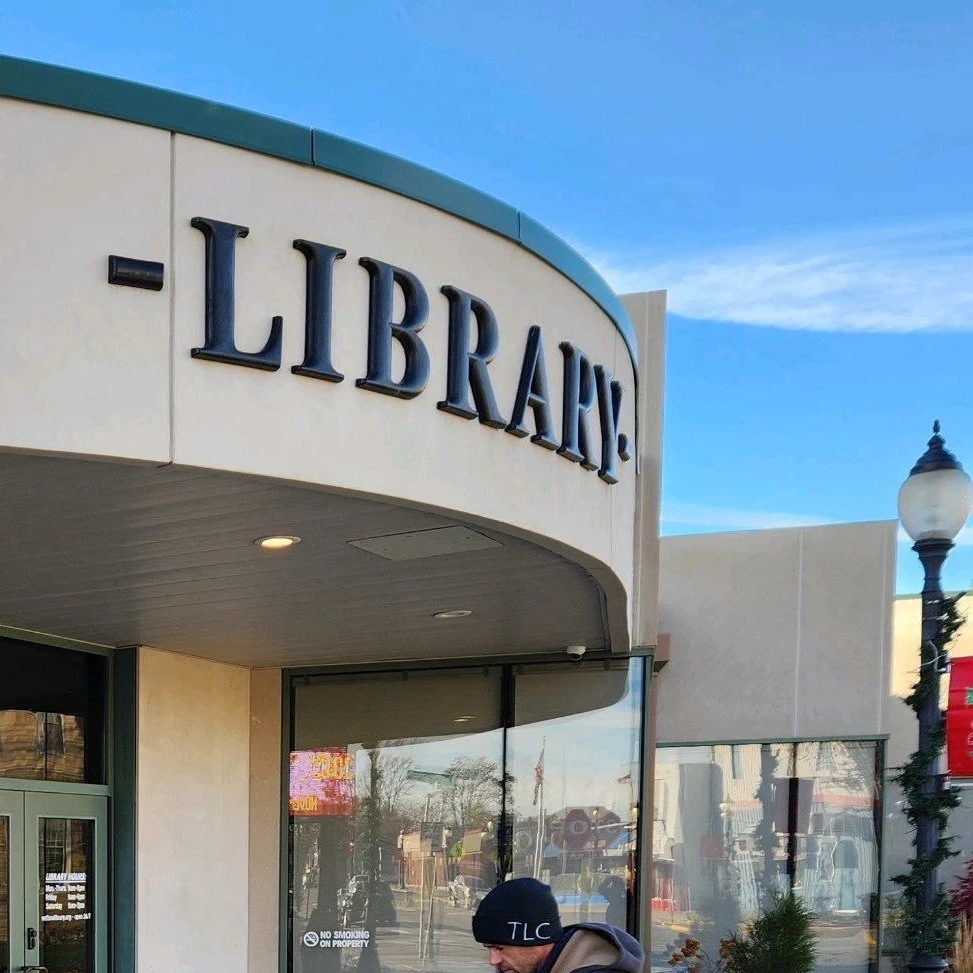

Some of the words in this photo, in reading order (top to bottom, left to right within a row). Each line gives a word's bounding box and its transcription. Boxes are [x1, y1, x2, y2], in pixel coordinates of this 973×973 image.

[319, 930, 332, 940] NO
[333, 930, 370, 940] SMOKING
[507, 921, 551, 941] TLC
[319, 939, 331, 948] ON
[332, 939, 370, 948] PROPERTY
